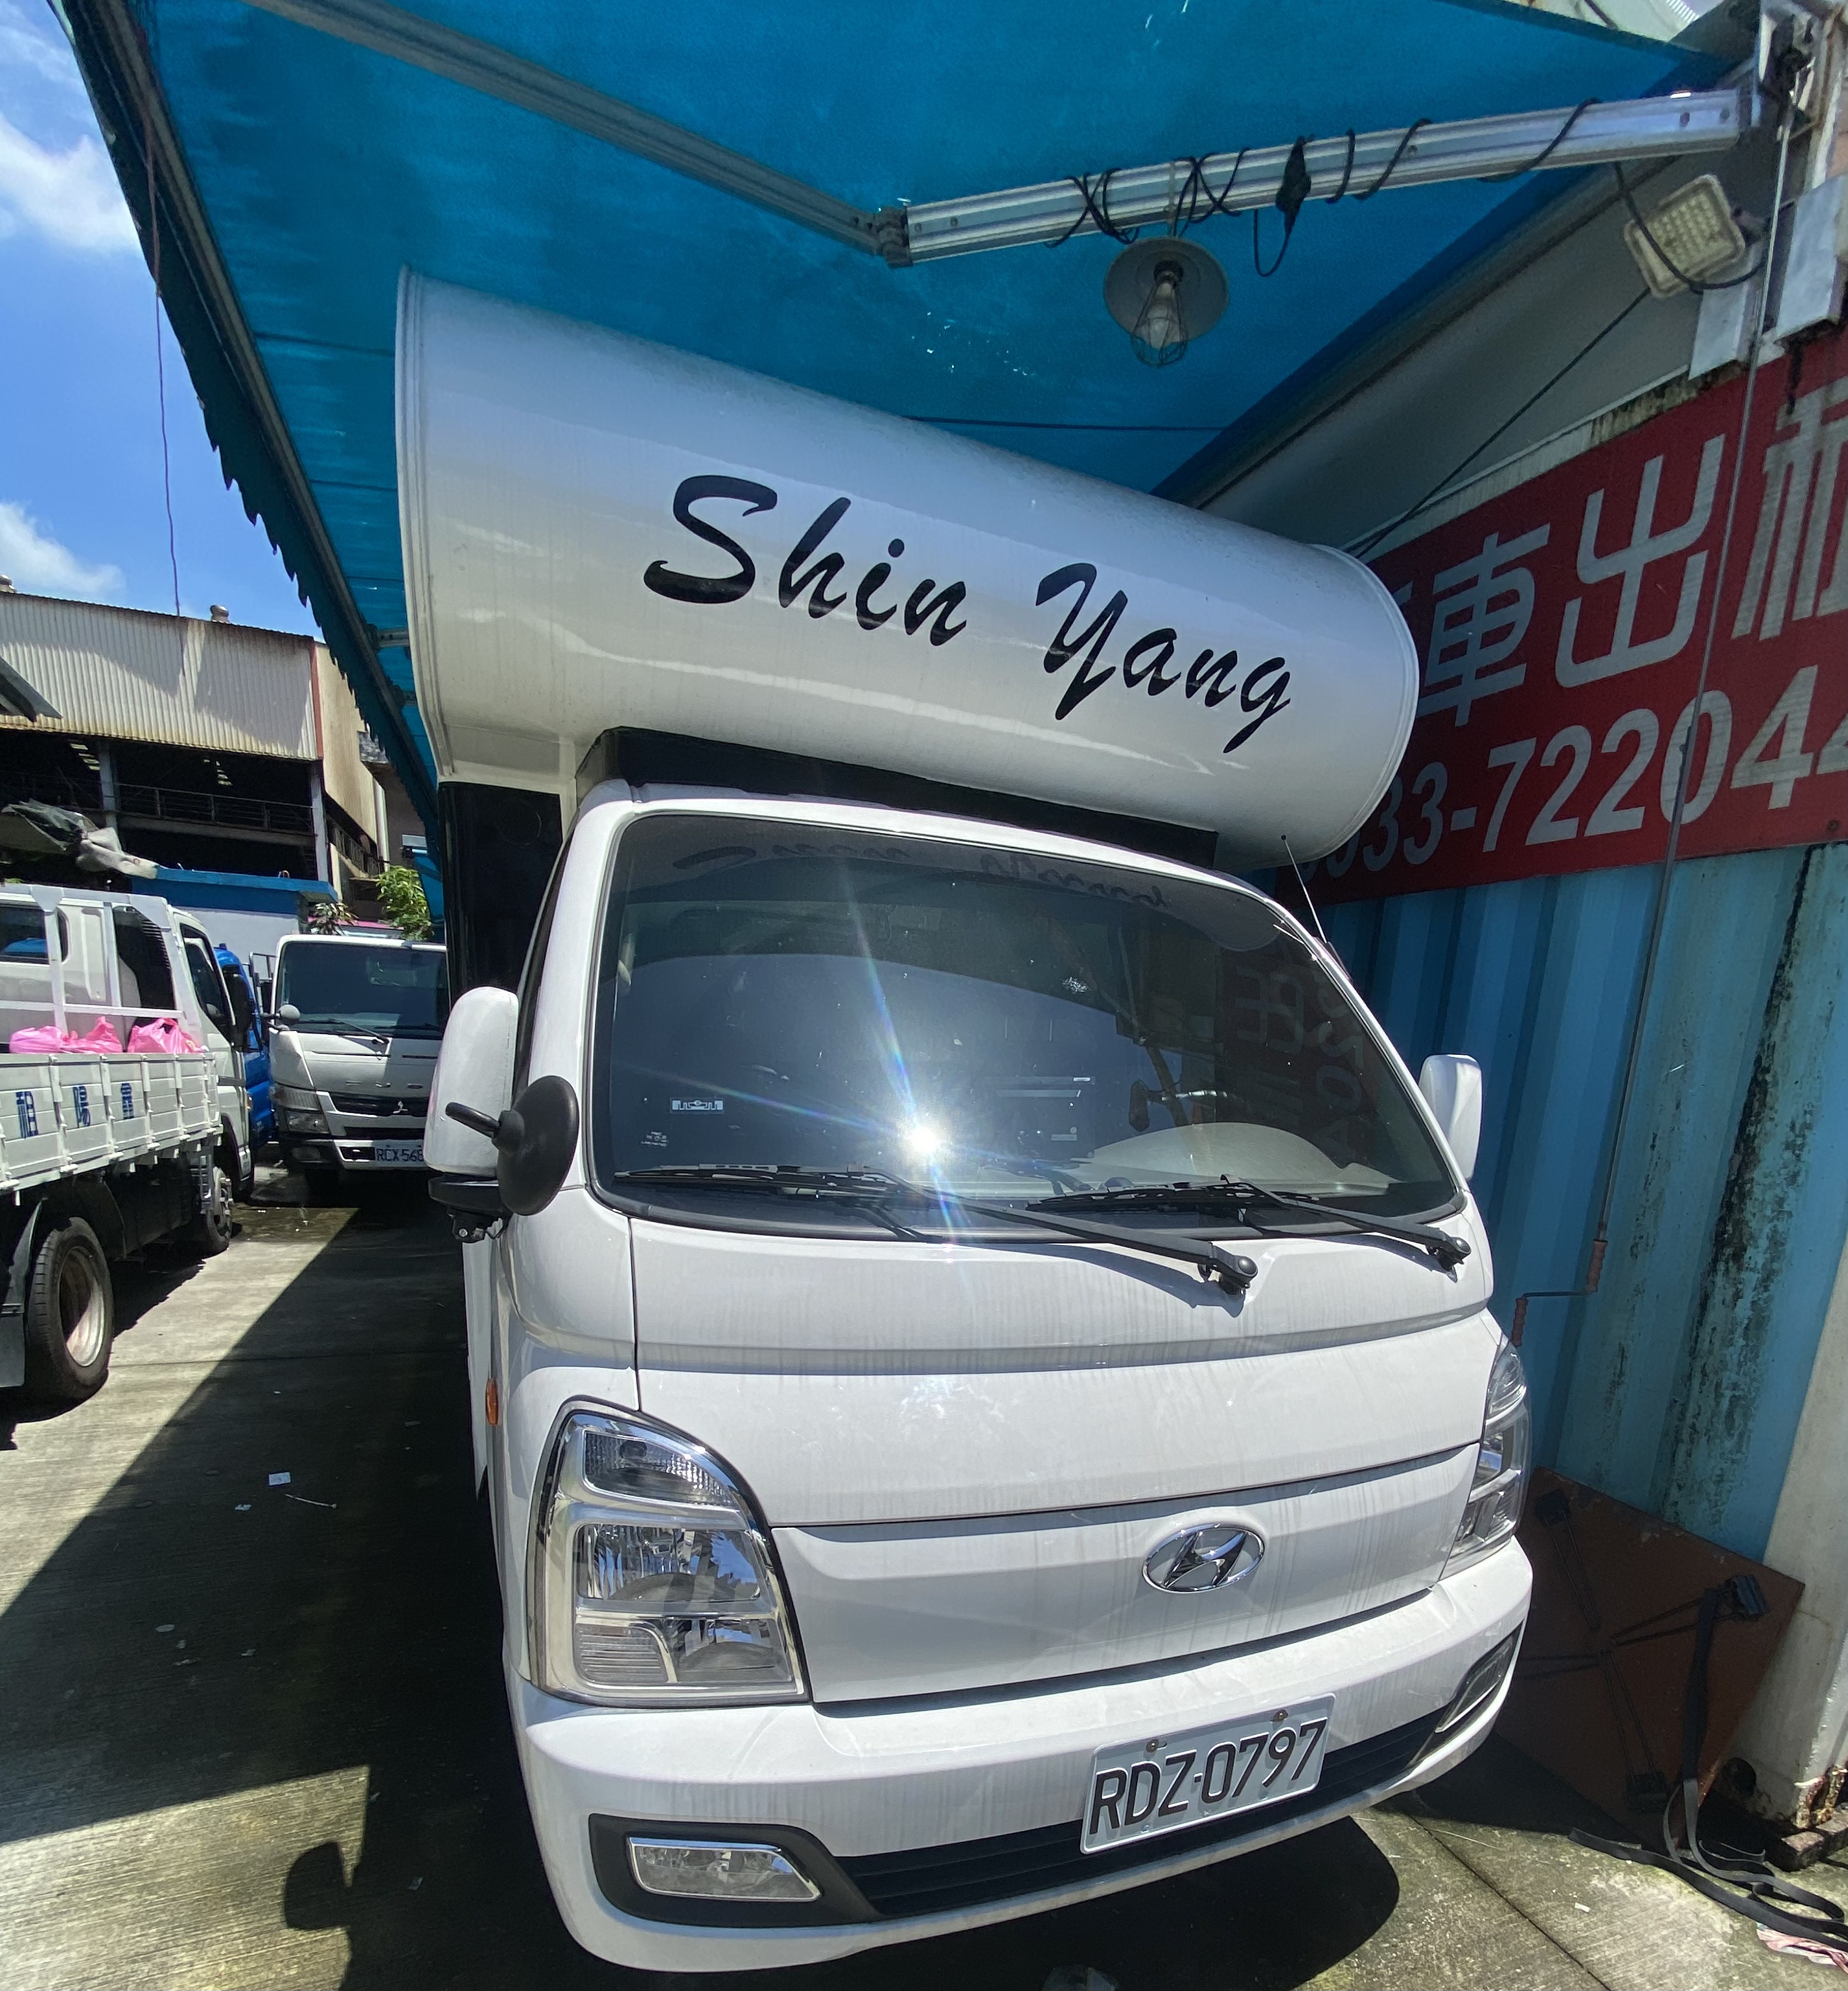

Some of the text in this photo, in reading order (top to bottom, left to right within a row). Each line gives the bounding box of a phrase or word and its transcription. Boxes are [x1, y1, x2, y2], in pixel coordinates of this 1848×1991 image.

[643, 474, 1291, 754] Shin Yang
[1299, 665, 1848, 884] 33-72204
[1089, 1716, 1328, 1835] RDZ-0797
